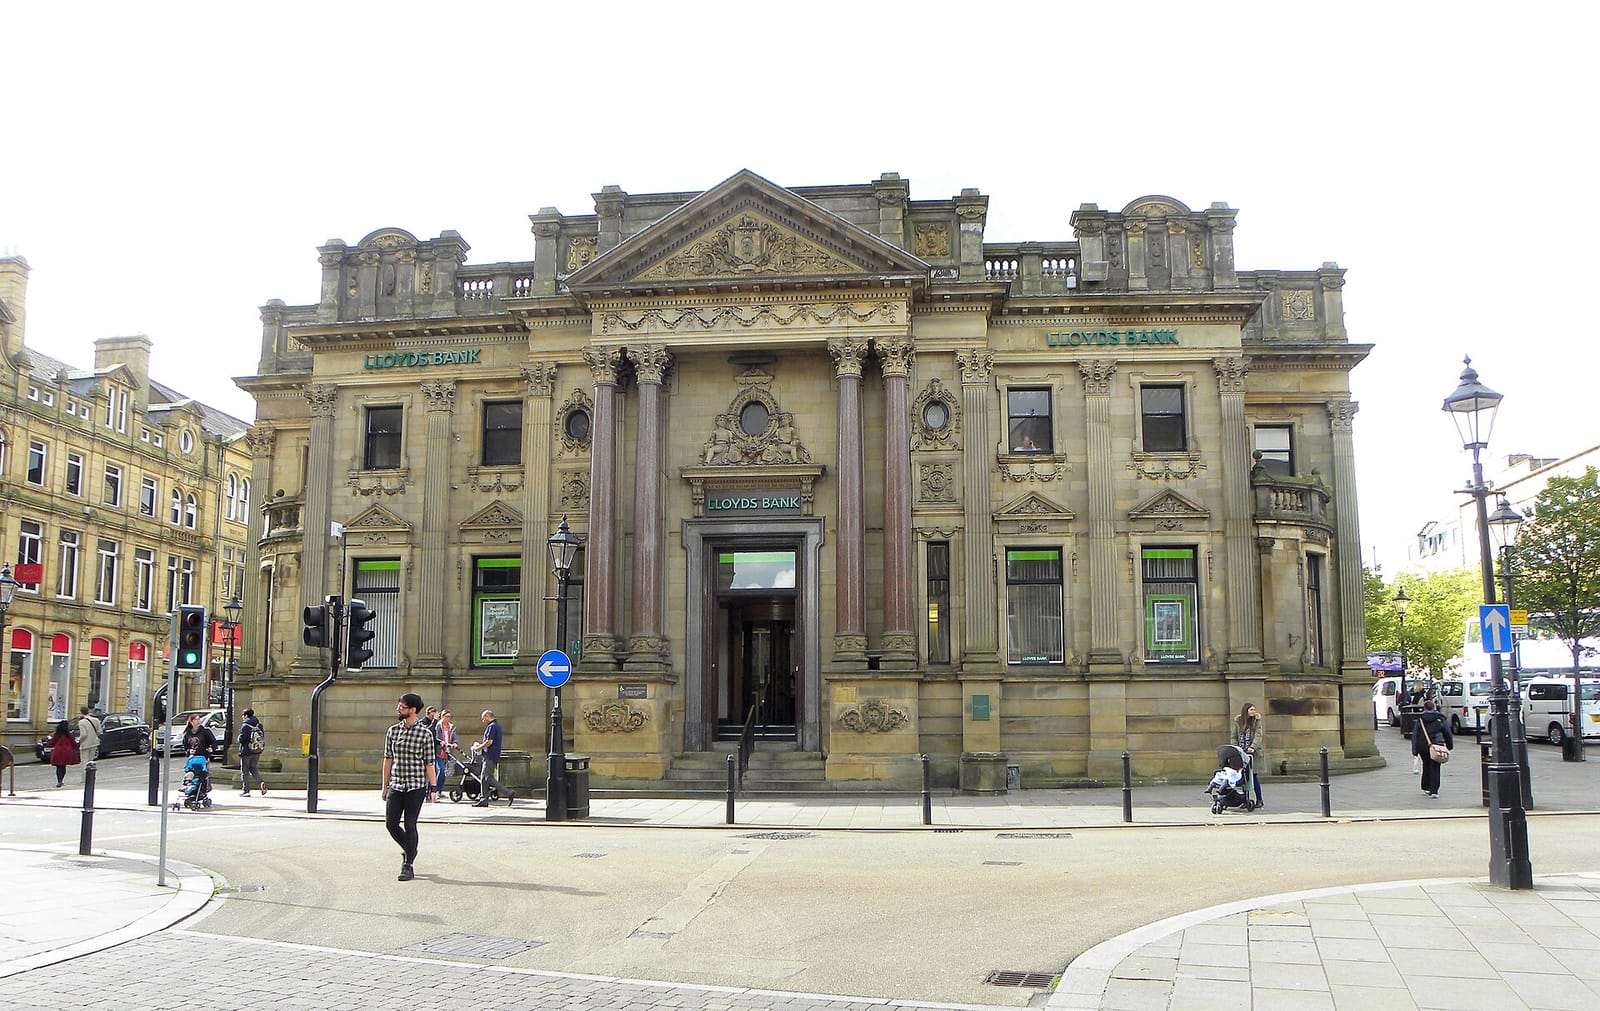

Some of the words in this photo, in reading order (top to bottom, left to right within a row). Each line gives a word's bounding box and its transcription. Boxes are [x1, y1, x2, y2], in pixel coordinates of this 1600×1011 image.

[1048, 328, 1120, 346] LLOYDS
[1124, 328, 1179, 345] BANK
[364, 352, 430, 369] LLOYDS
[432, 348, 482, 366] BANK
[707, 497, 758, 510] LLOYDS
[762, 496, 800, 509] BANK
